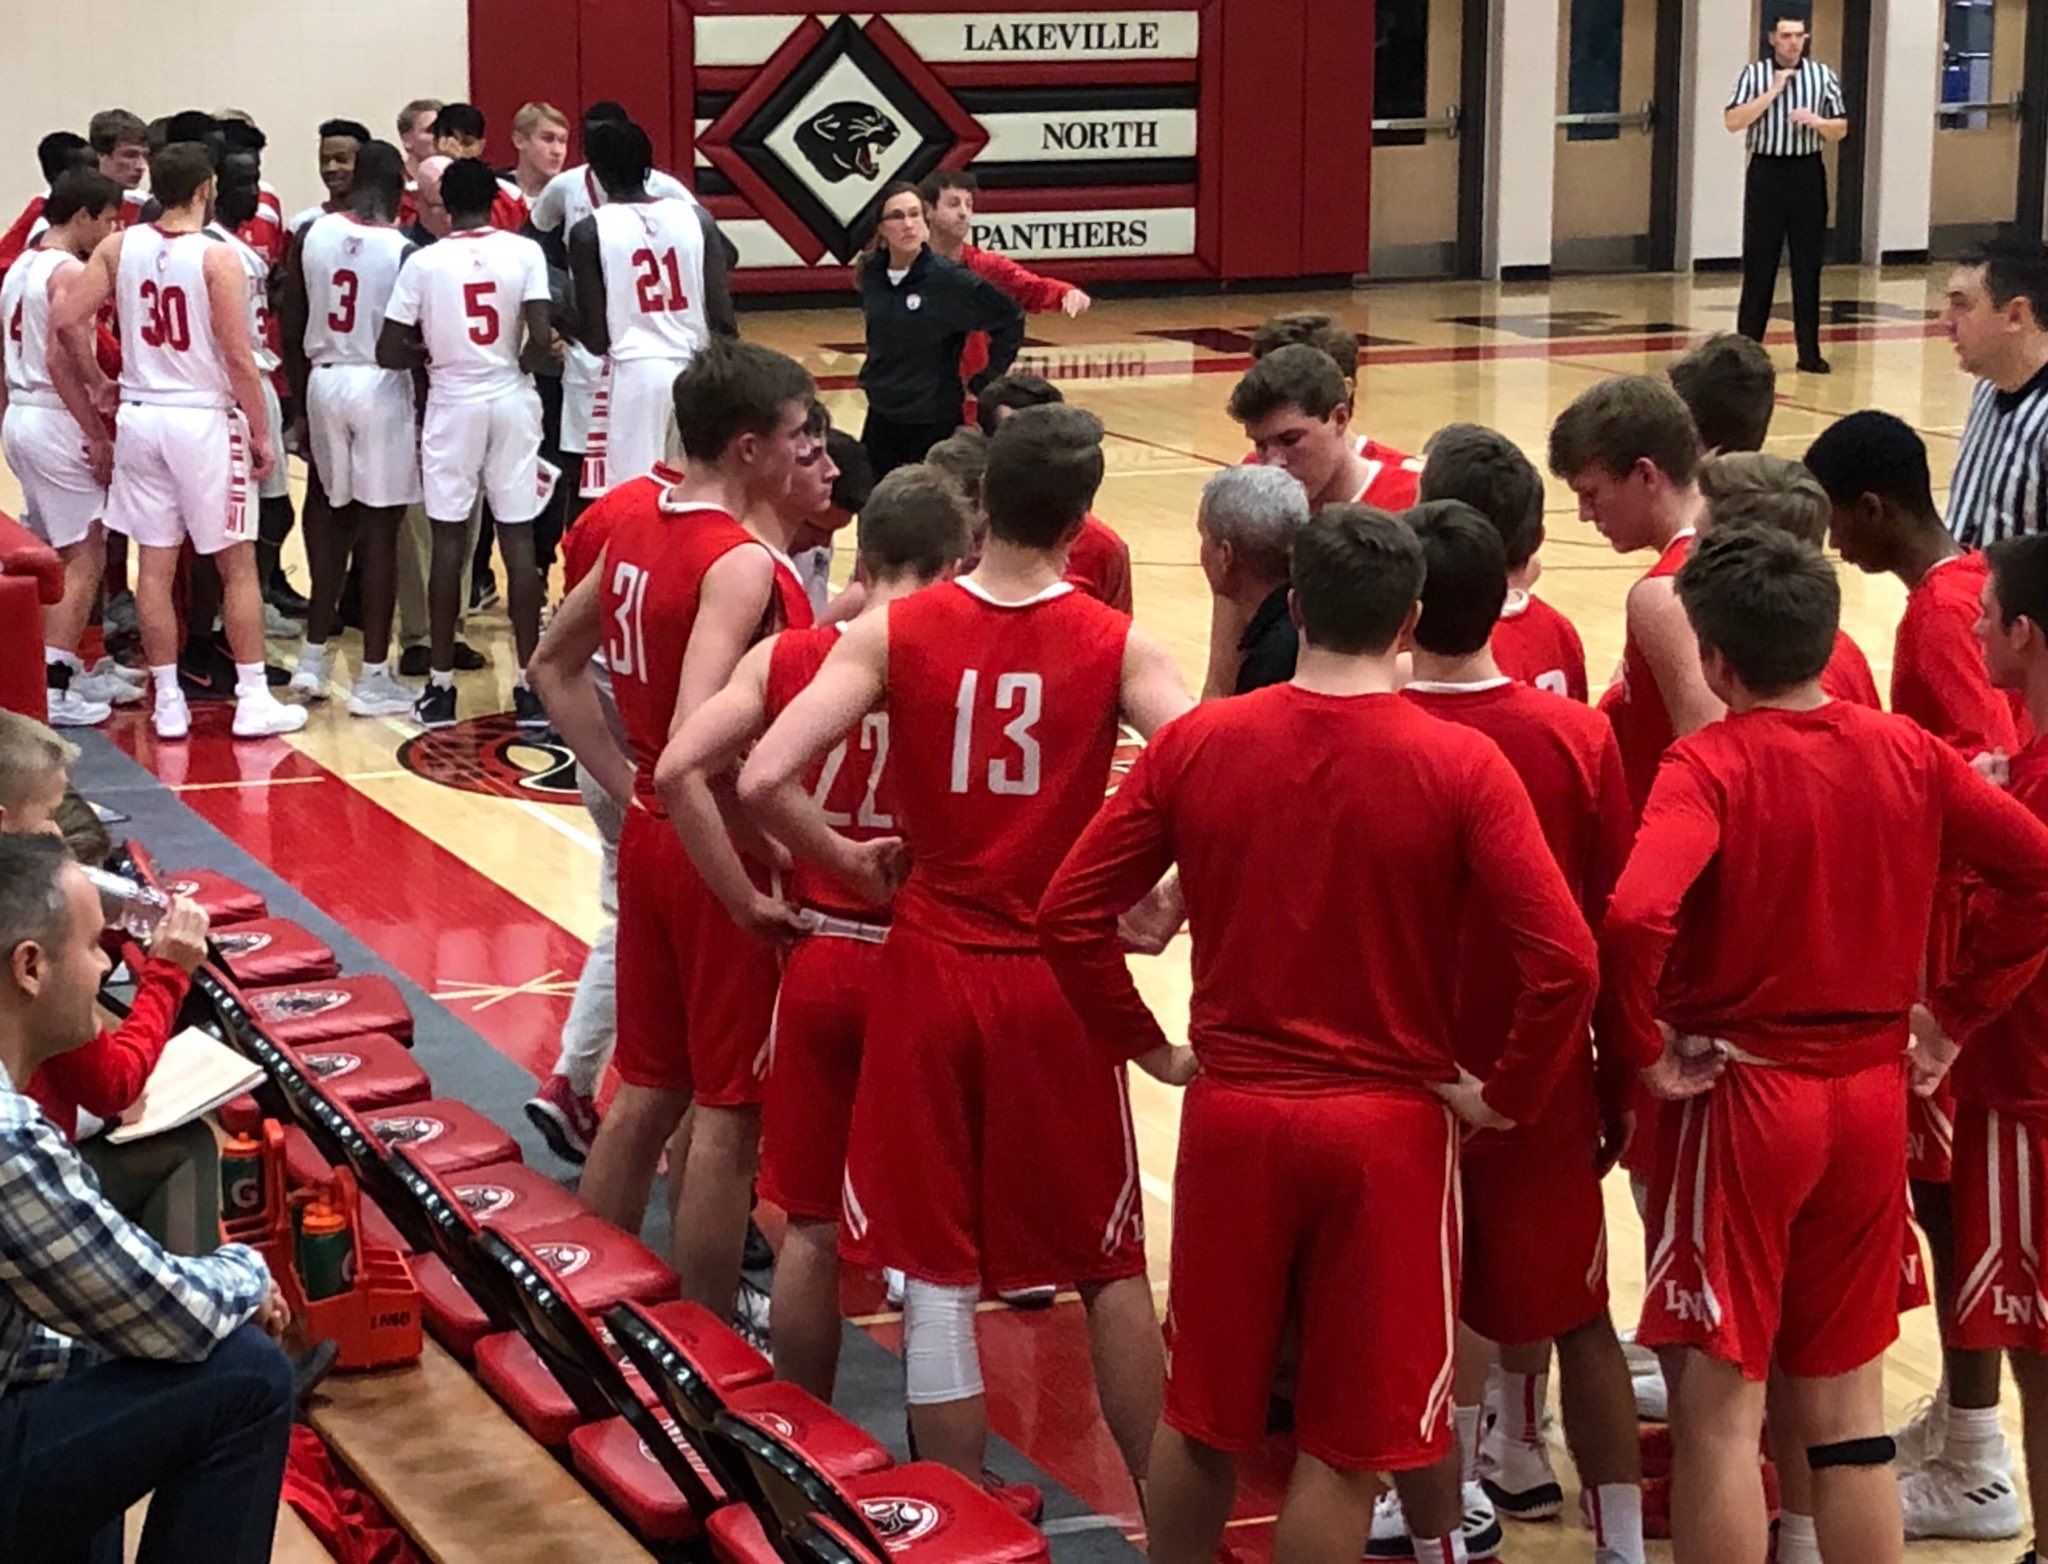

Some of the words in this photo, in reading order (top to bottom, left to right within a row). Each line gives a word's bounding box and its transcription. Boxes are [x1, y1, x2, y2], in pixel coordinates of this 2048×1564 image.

[963, 22, 1160, 51] LAKEVILLE
[1041, 121, 1159, 150] NORTH
[970, 219, 1148, 251] PANTHERS
[327, 268, 359, 334] 3
[631, 246, 689, 314] 21
[139, 278, 191, 352] 30
[462, 280, 500, 346] 5
[609, 560, 650, 685] 31
[950, 667, 1043, 797] 13
[1900, 1253, 1919, 1286] N
[1663, 1279, 1703, 1322] LN
[1992, 1285, 2033, 1335] LN
